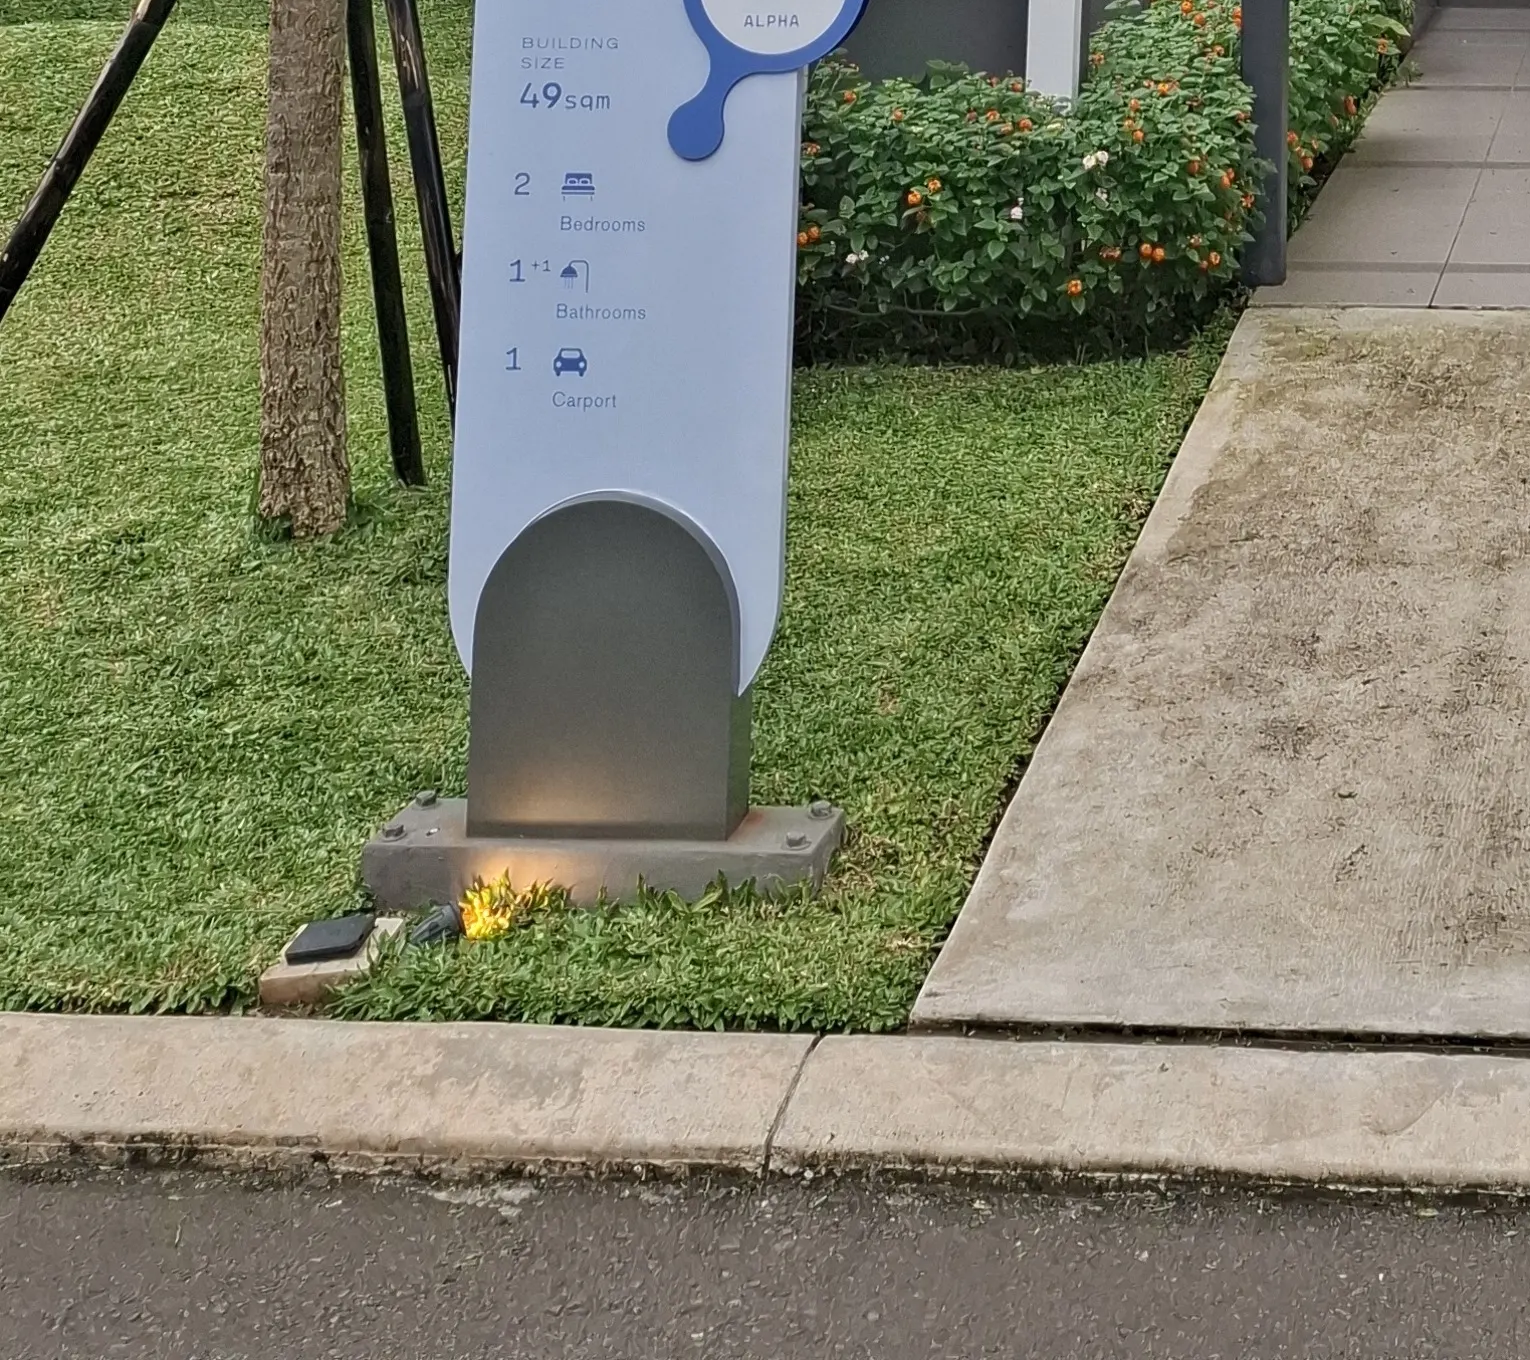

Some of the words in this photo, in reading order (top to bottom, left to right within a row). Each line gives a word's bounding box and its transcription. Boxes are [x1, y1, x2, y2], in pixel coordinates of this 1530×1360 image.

[743, 14, 800, 28] ALPHA
[521, 36, 620, 50] BUILDING
[520, 56, 566, 70] SIZE
[519, 81, 611, 110] 49sqm
[513, 172, 532, 196] 2
[559, 215, 647, 232] Bedrooms
[555, 303, 647, 321] Bathrooms
[504, 346, 522, 371] 1
[551, 391, 618, 412] Carport
